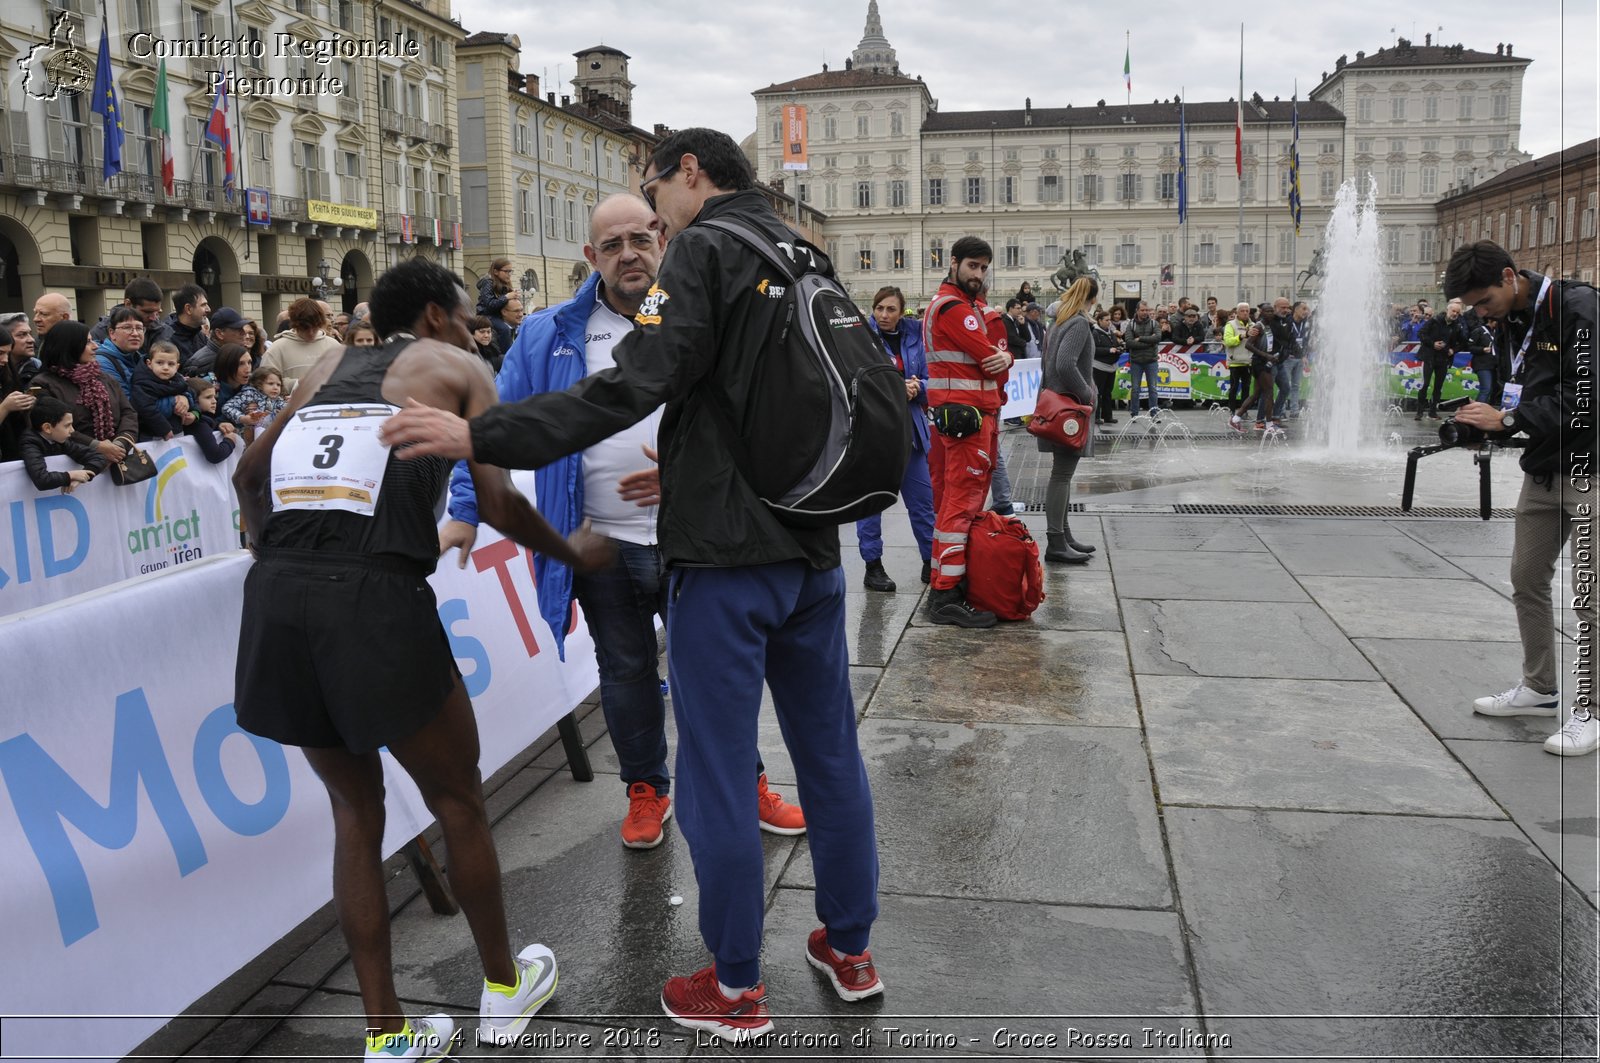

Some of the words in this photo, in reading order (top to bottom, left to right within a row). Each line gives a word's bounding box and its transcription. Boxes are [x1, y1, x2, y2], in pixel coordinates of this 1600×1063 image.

[330, 206, 341, 216] PER
[341, 208, 357, 218] GIULIO
[264, 278, 316, 293] REGIO
[829, 315, 860, 326] PAVARIN
[592, 332, 612, 342] asics
[1026, 370, 1042, 399] M
[312, 434, 344, 470] 3
[127, 509, 200, 554] amiat
